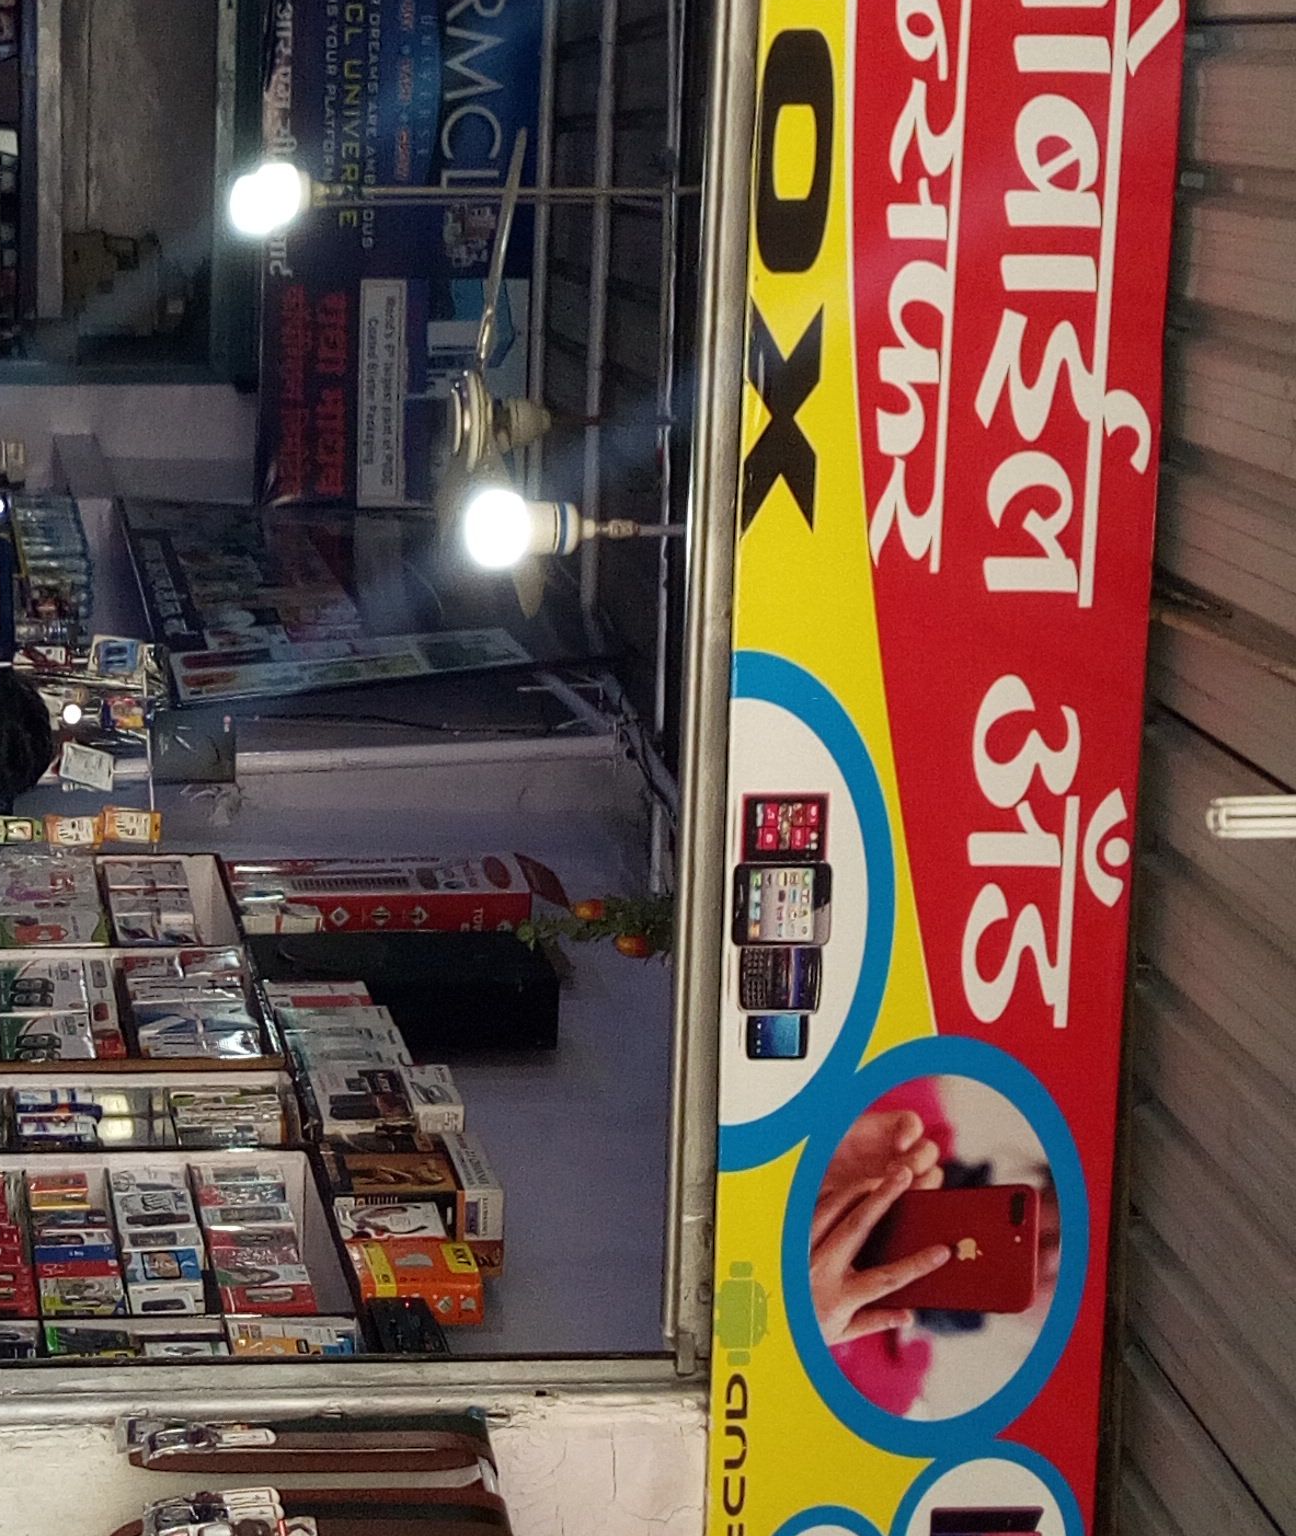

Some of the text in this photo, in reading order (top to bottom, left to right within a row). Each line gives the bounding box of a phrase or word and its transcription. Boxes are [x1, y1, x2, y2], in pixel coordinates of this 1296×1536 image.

[324, 24, 338, 75] YOUR
[366, 13, 382, 94] DREAMS
[337, 58, 364, 229] UNIVERE
[364, 101, 380, 129] ARE
